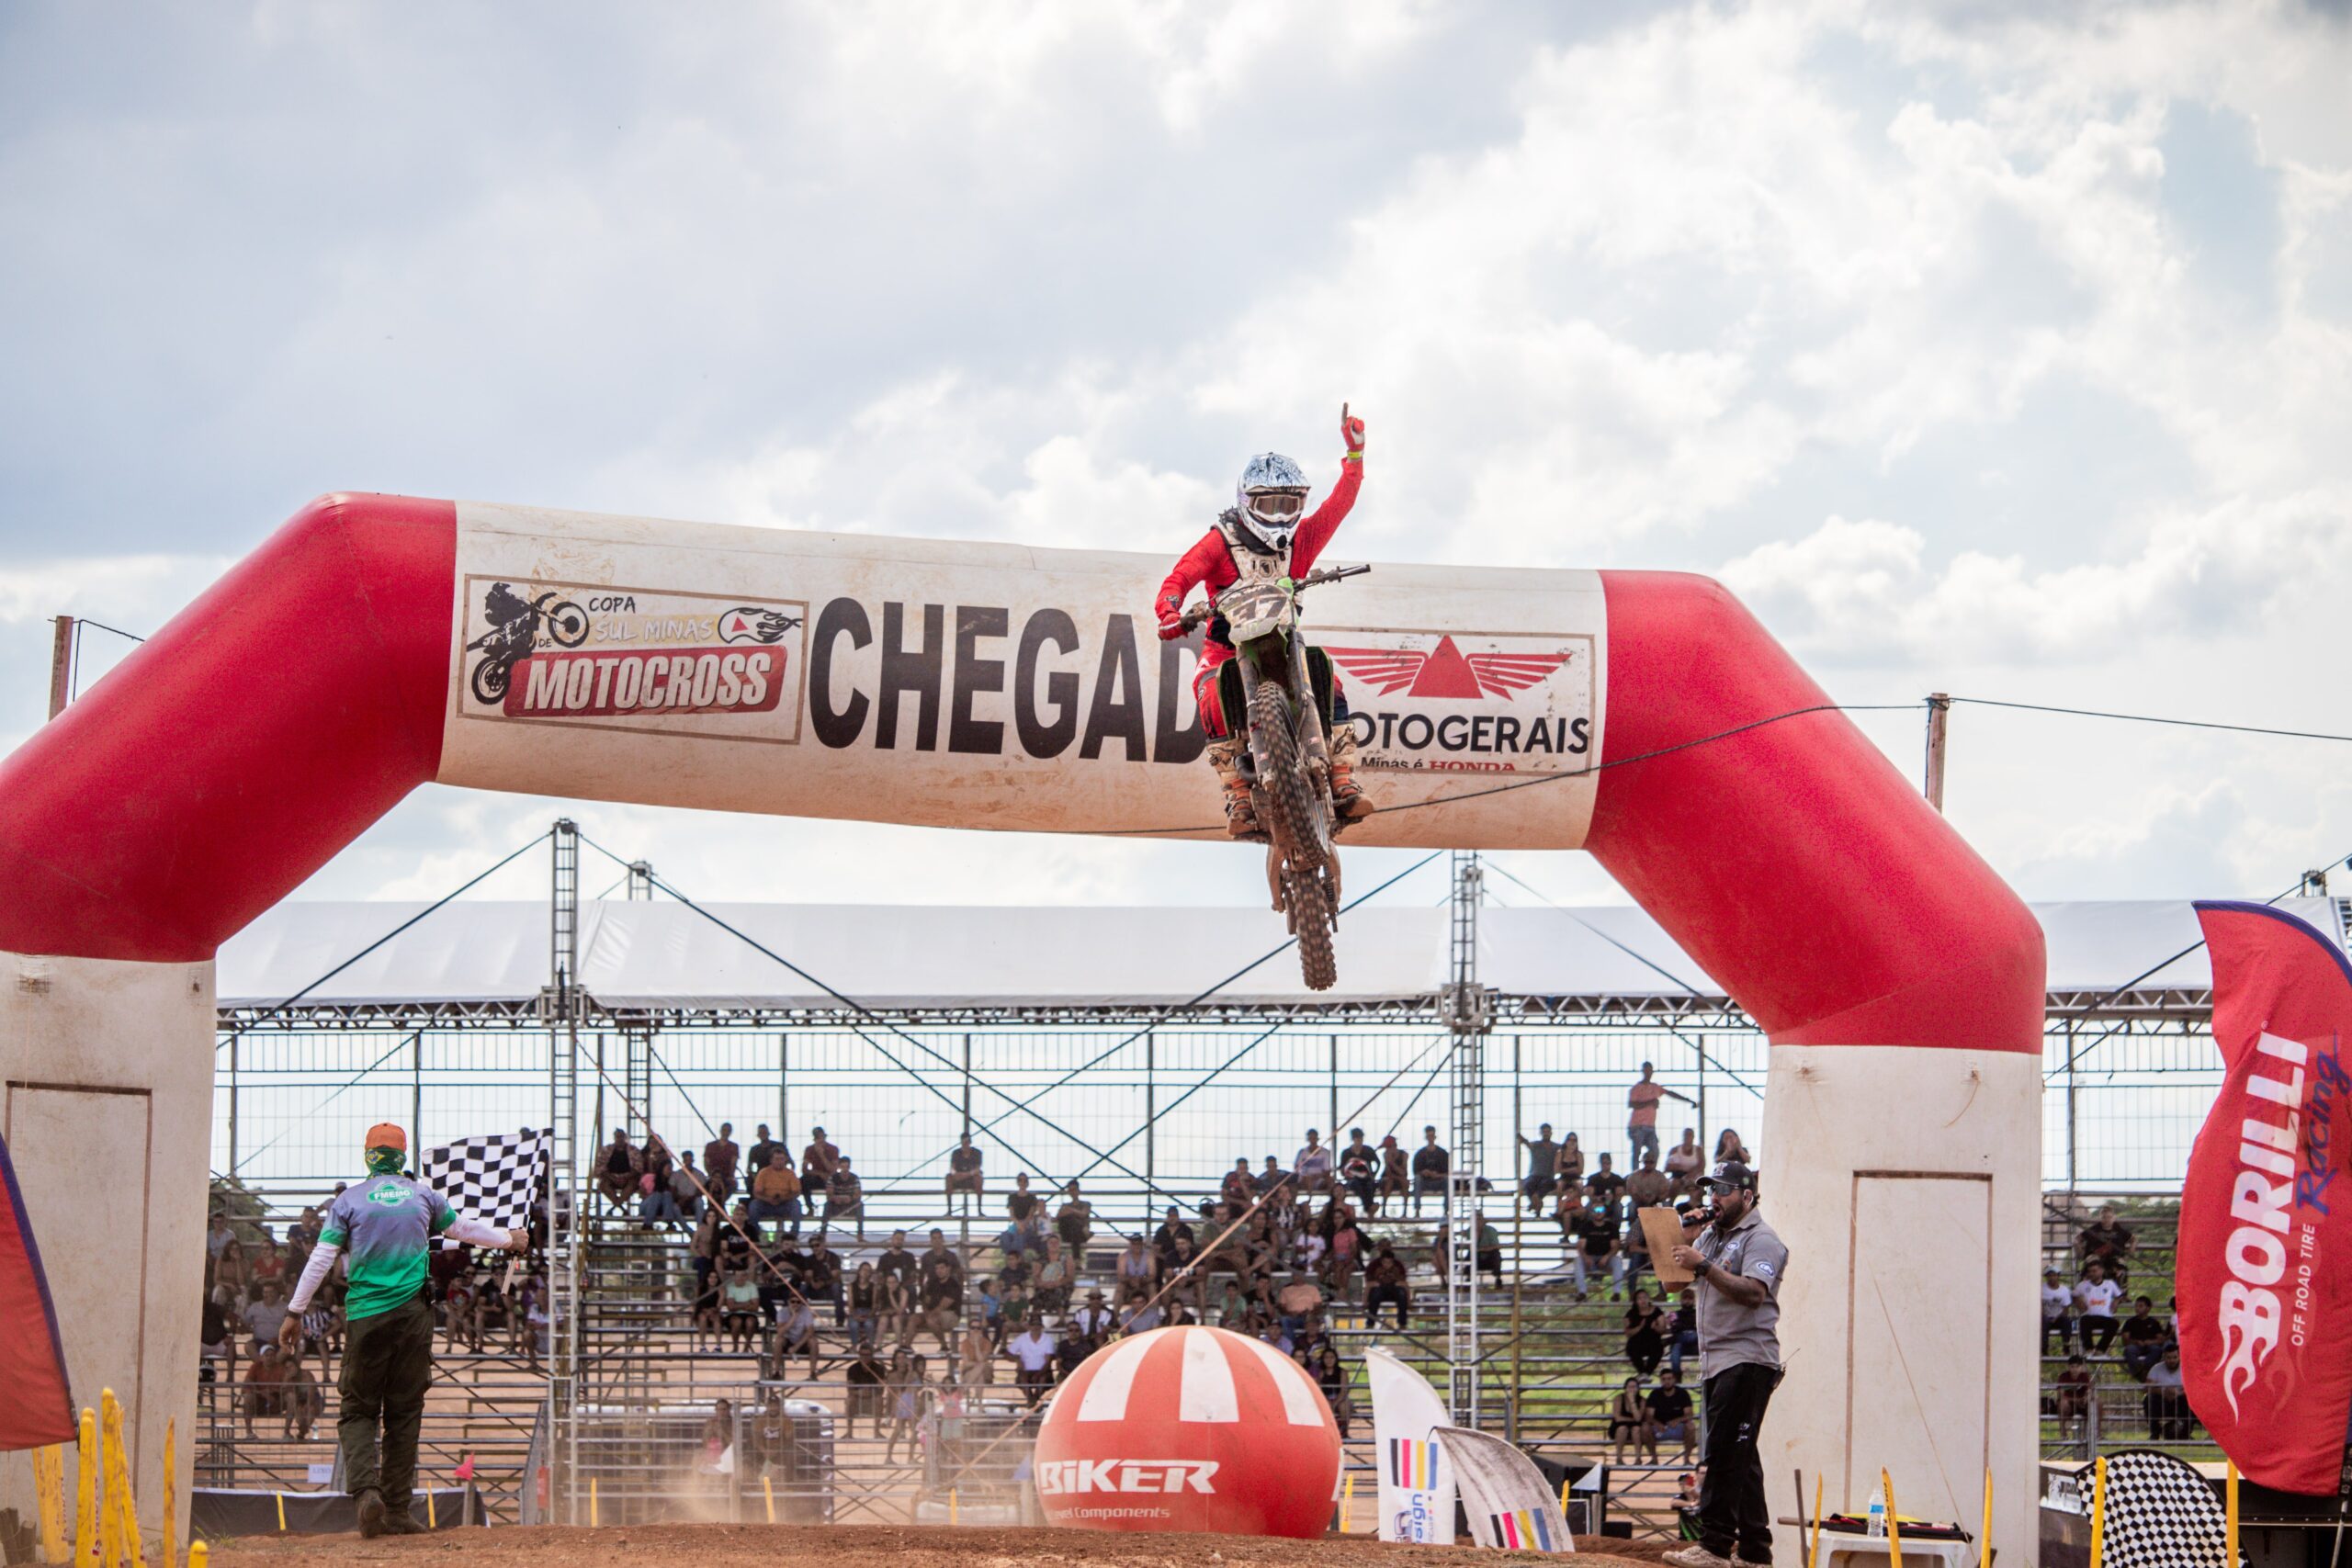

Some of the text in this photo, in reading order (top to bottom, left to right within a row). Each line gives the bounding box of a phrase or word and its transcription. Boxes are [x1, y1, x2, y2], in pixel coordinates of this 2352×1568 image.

[589, 596, 636, 613] COPA
[538, 638, 551, 648] DE
[594, 617, 714, 642] SUL MINAS
[524, 652, 771, 710] MOTOCROSS
[808, 597, 1207, 764] CHEGAD
[1348, 711, 1589, 754] OTOGERAIS
[1429, 761, 1515, 772] HONDA
[2297, 1029, 2352, 1216] Racing
[2214, 1032, 2308, 1425] BORILLI
[2291, 1224, 2315, 1347] OFF ROAD TIRE
[1074, 1506, 1171, 1520] Components
[1412, 1494, 1426, 1543] sign
